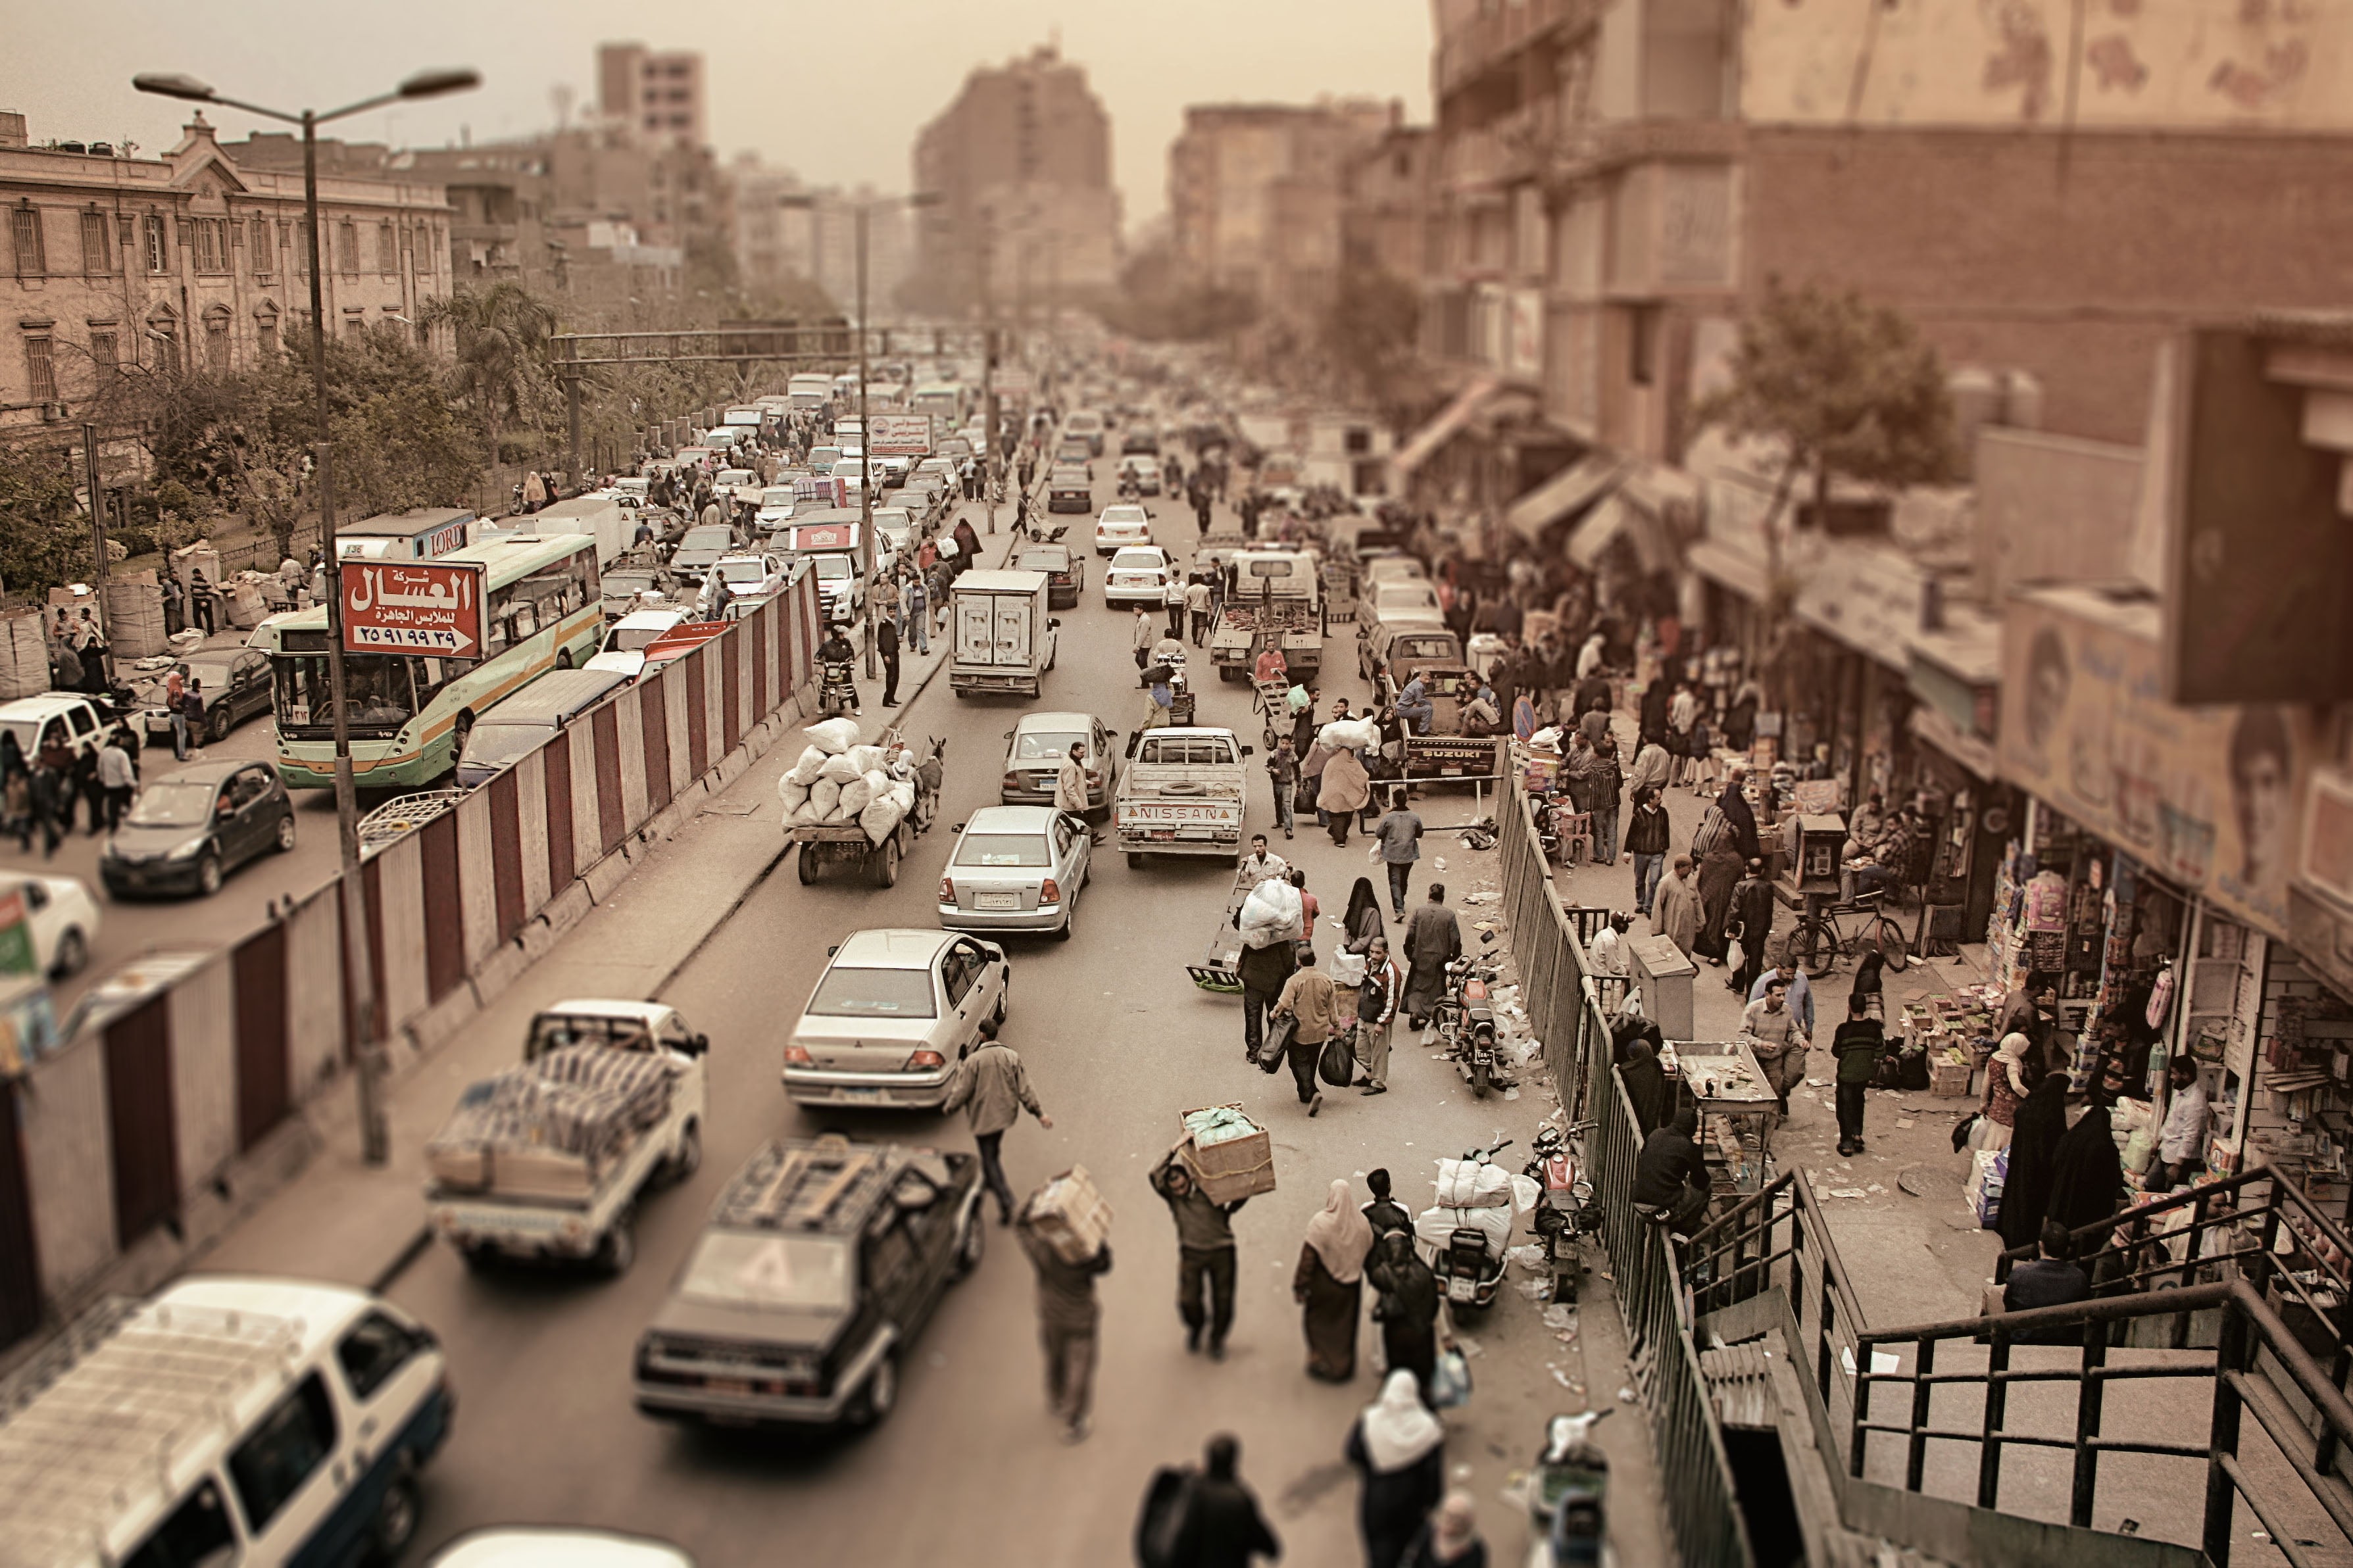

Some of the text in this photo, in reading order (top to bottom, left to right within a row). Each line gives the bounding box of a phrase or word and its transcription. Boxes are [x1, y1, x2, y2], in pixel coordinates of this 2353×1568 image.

[430, 524, 462, 557] LORD
[392, 570, 430, 585] شركة
[350, 566, 471, 612] العسال
[375, 606, 456, 626] للملابس الجاهزة
[1140, 807, 1217, 820] NISSAN
